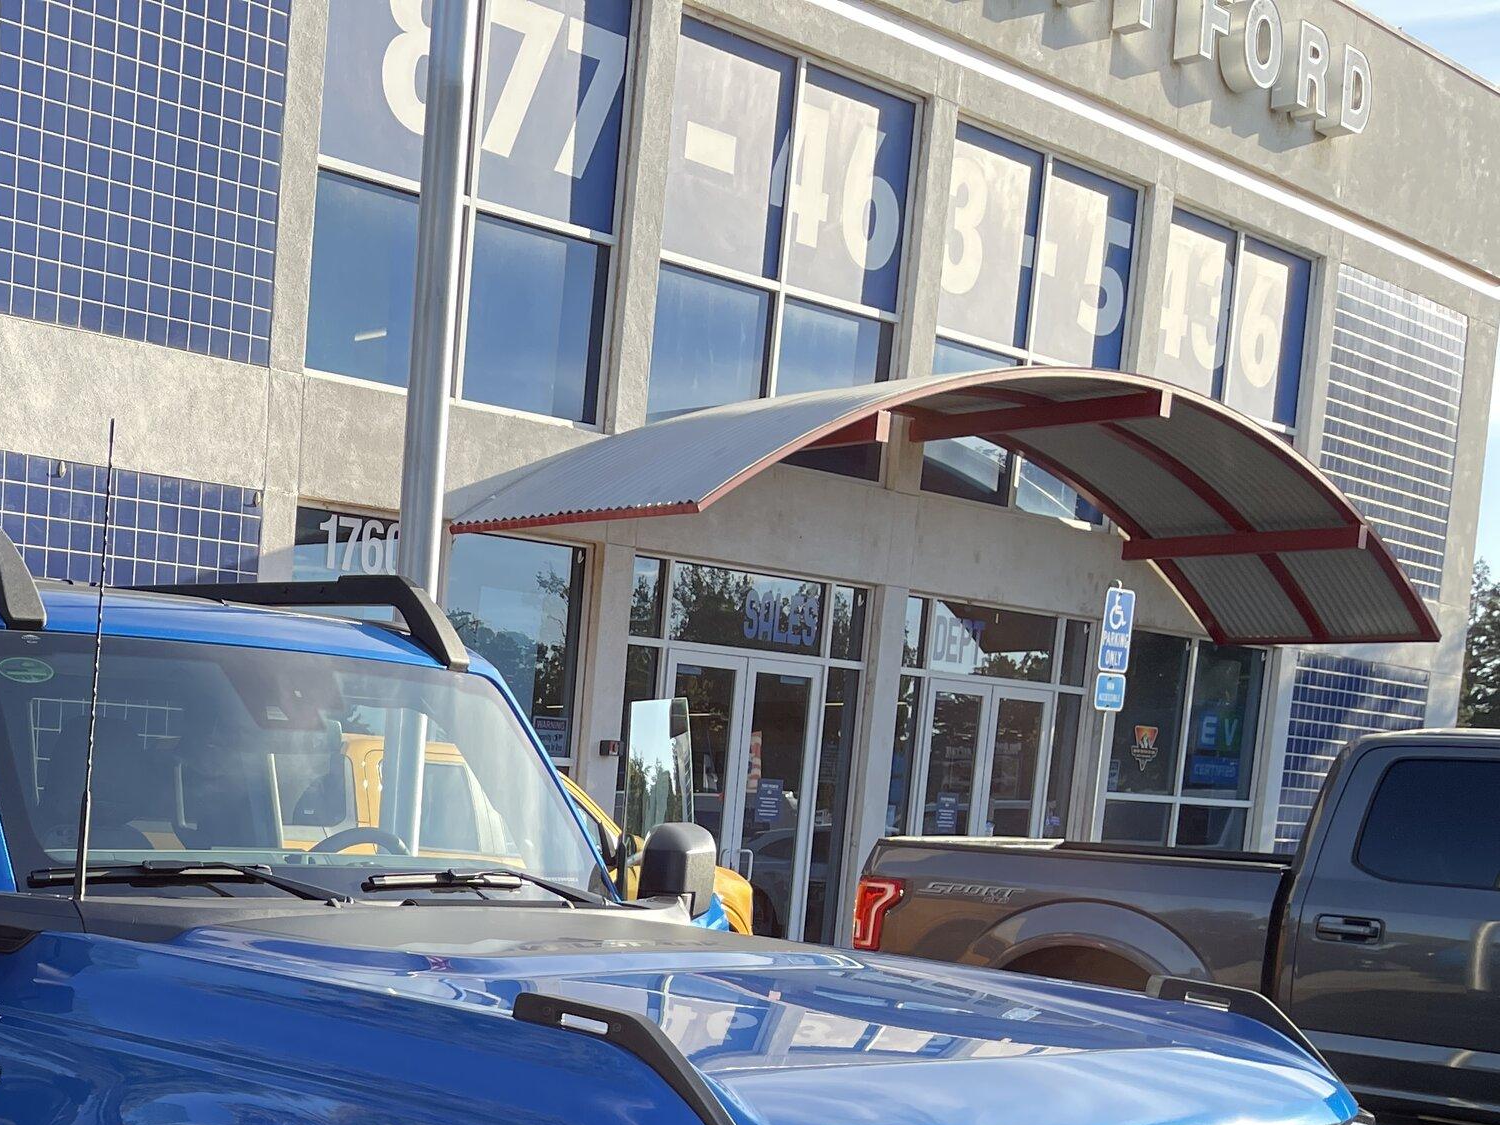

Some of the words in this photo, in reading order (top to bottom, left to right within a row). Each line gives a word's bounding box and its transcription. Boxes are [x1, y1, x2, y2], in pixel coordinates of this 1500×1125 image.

[743, 588, 819, 646] SALES
[932, 614, 986, 666] DEPT
[1102, 630, 1129, 649] PARKING
[1105, 649, 1123, 666] ONLY
[917, 881, 1026, 898] SPORT
